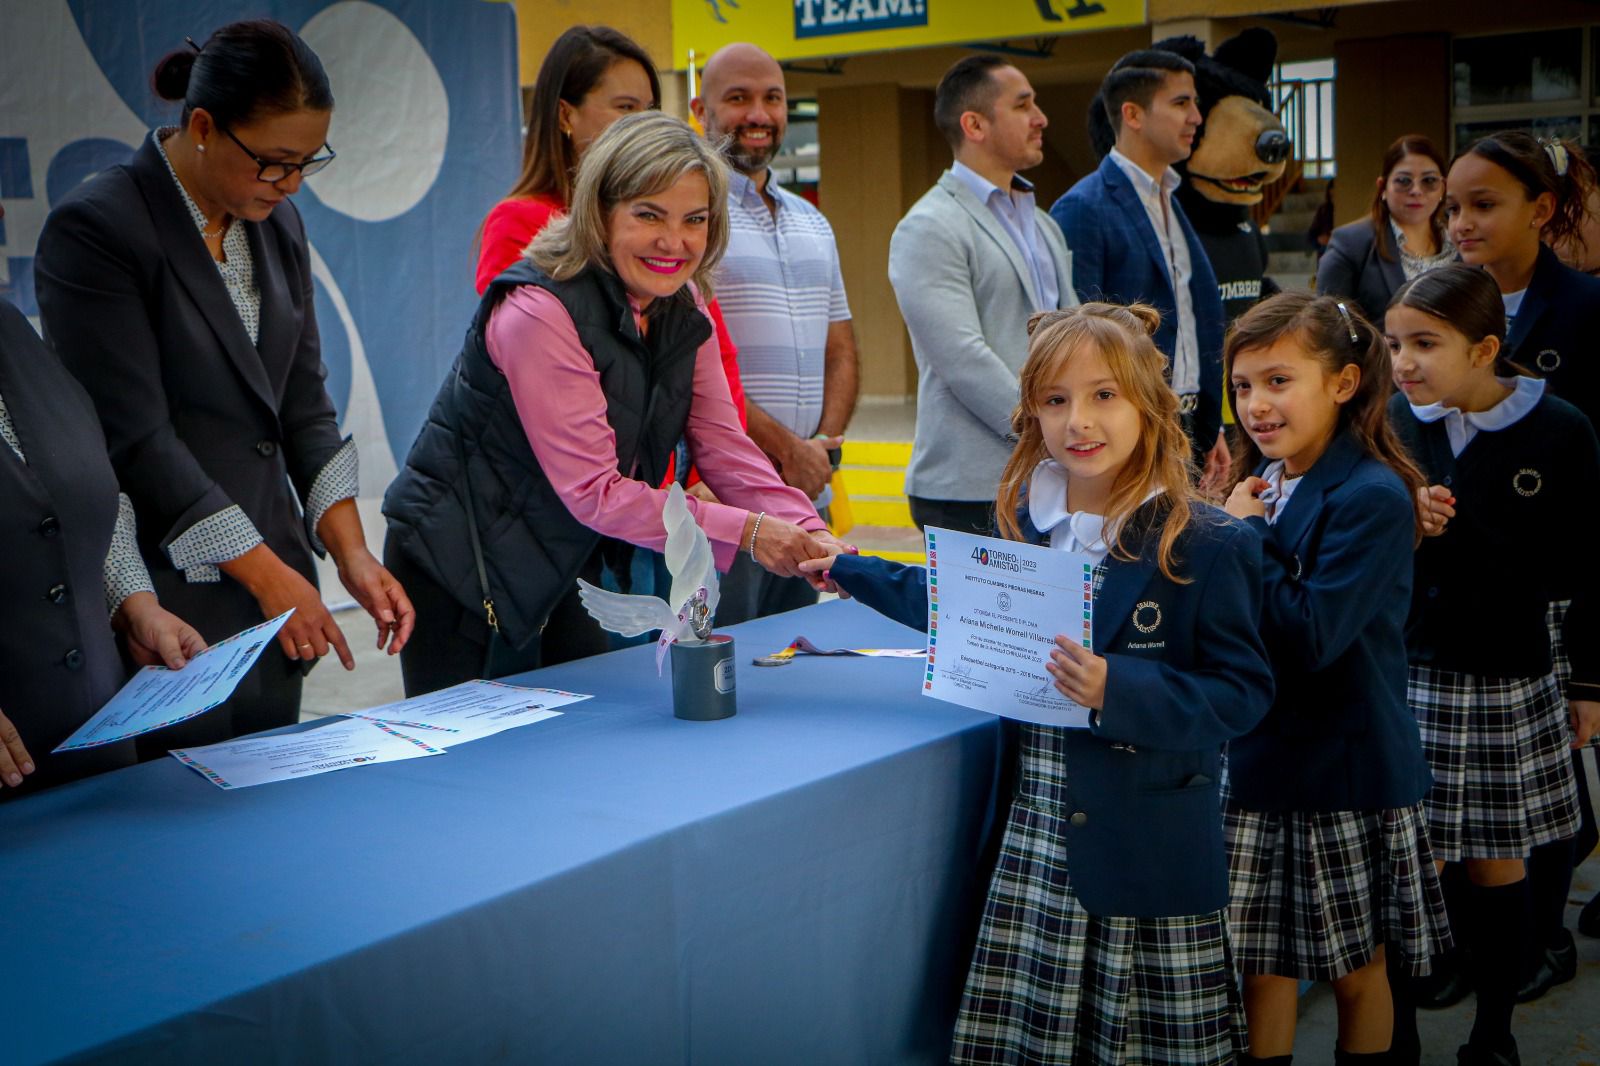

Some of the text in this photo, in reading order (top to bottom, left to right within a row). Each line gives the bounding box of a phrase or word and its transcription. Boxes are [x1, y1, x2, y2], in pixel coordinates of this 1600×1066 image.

[971, 546, 1017, 566] 40 TORNEO
[1022, 559, 1037, 569] 2023
[989, 559, 1019, 573] AMISTAD
[959, 615, 979, 627] Ariana
[979, 620, 1005, 633] Michelle
[1005, 625, 1028, 639] Worrell
